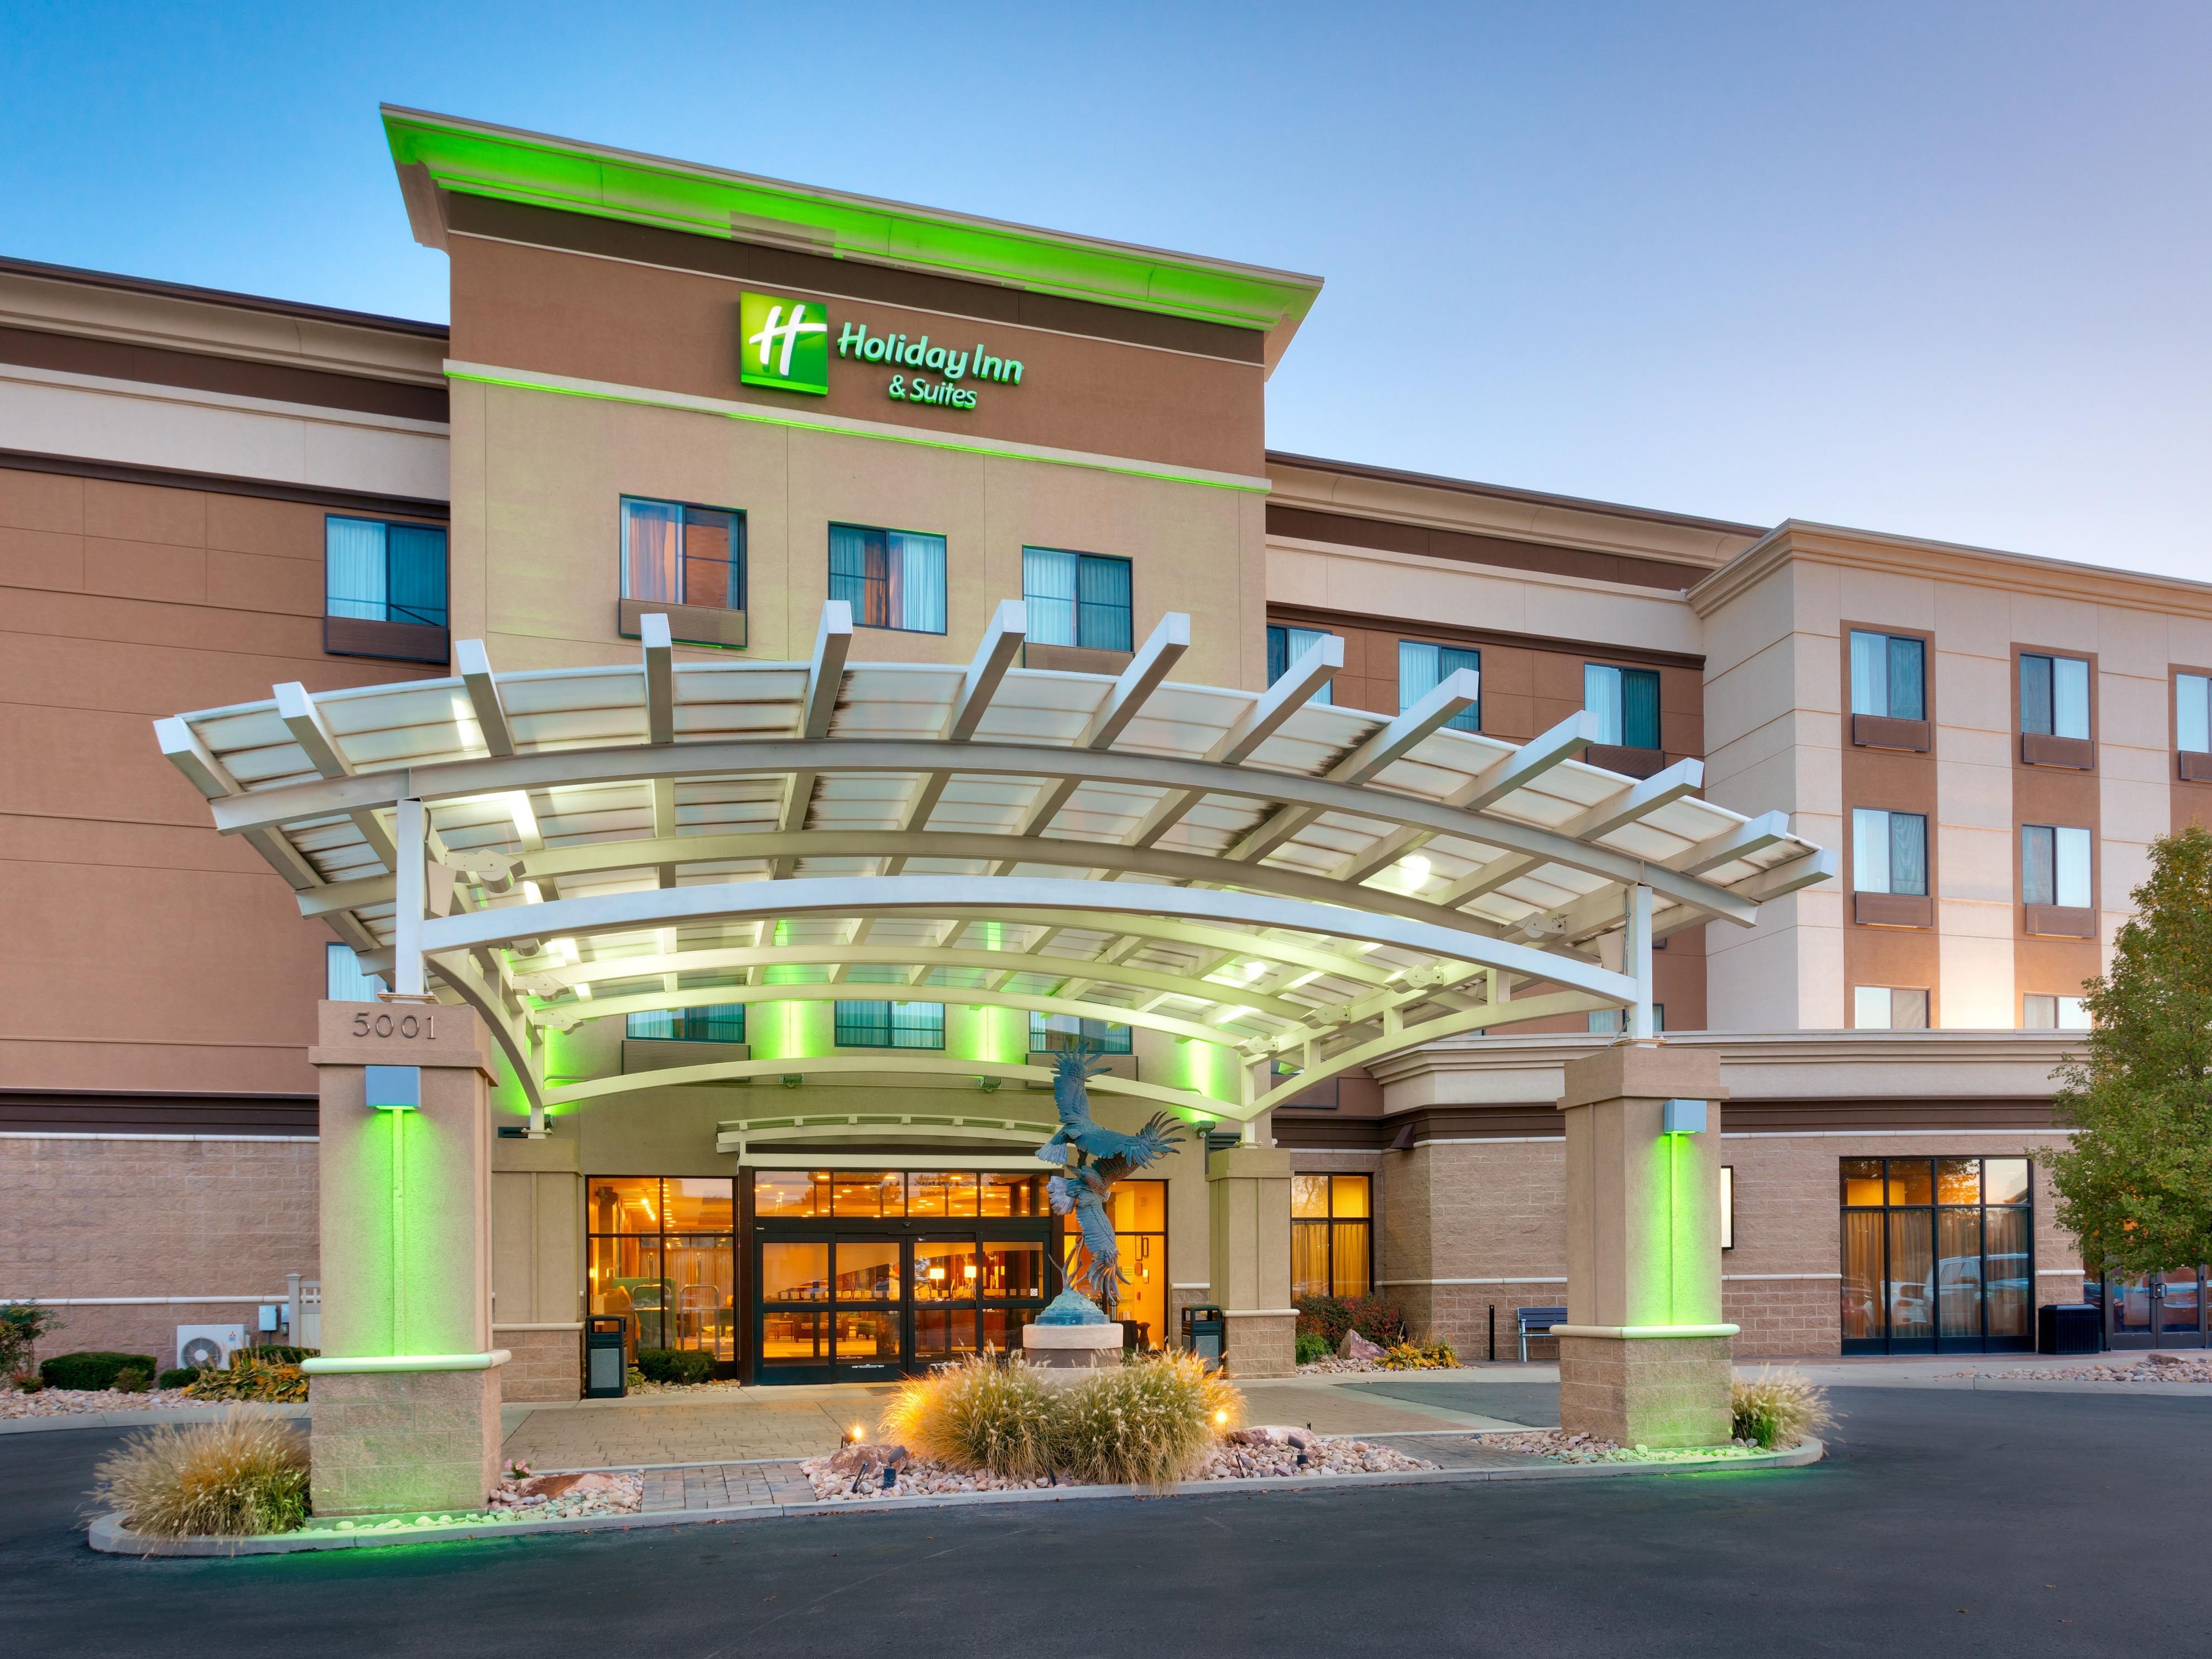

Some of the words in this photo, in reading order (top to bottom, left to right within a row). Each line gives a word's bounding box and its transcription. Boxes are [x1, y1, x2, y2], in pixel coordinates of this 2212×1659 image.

[749, 304, 827, 376] H
[837, 322, 968, 382] Holiday
[972, 343, 1023, 385] Inn
[889, 374, 906, 399] &
[909, 378, 978, 409] Suites
[353, 1011, 436, 1040] 5001
